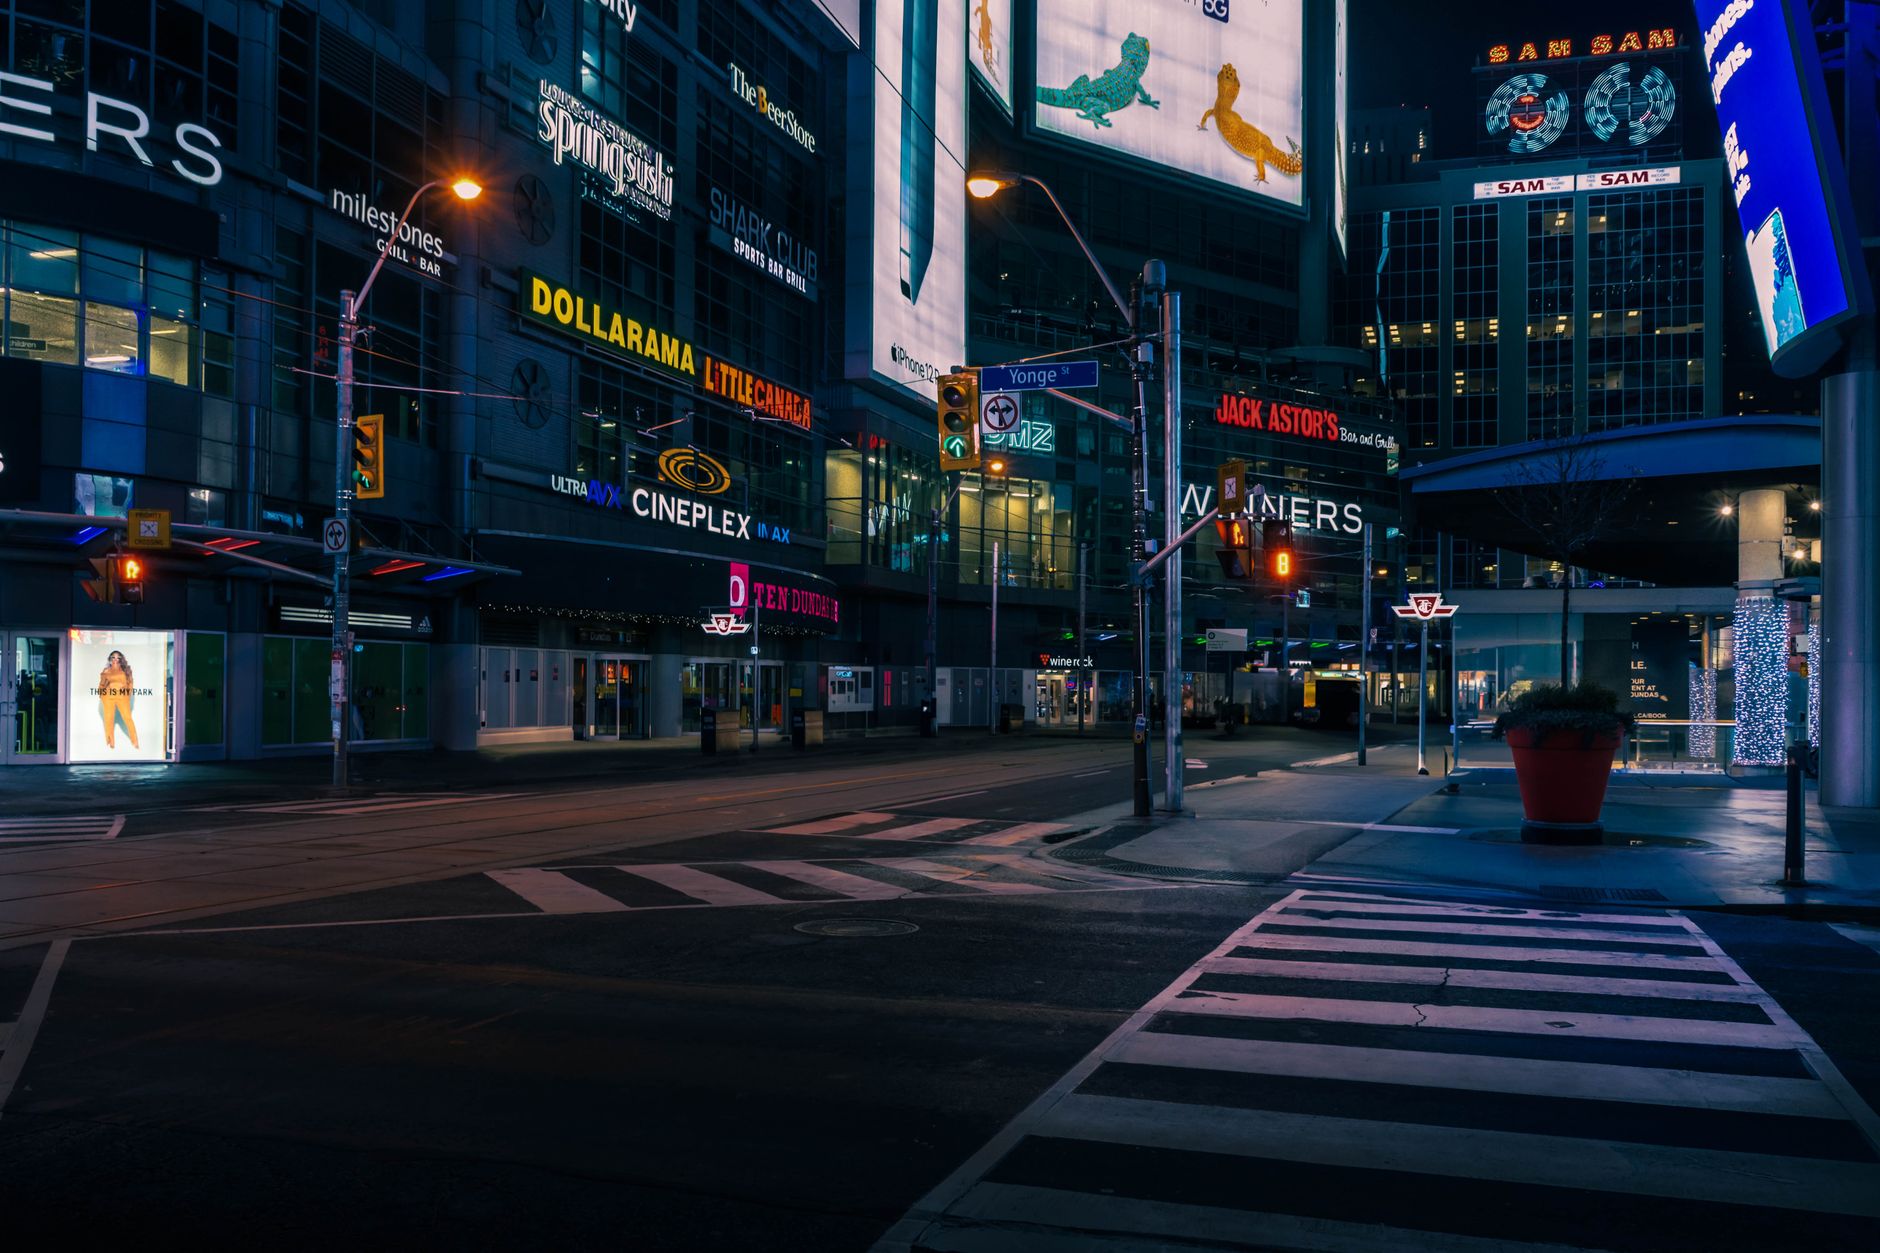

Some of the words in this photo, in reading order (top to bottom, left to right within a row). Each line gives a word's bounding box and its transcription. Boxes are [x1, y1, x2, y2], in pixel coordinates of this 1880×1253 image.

[1489, 39, 1571, 63] SAM
[1591, 28, 1676, 55] SAM
[1498, 180, 1545, 194] SAM
[1601, 171, 1649, 186] SAM
[333, 188, 443, 258] milestones
[710, 187, 772, 256] SHARK
[777, 230, 818, 282] CLUB
[420, 256, 442, 278] BAR
[733, 237, 765, 269] SPORTS
[768, 257, 784, 280] BAR
[786, 268, 807, 294] GRILL
[532, 276, 696, 376] DOLLARAMA
[897, 346, 925, 378] iPhone
[925, 363, 934, 384] 12
[1009, 368, 1057, 387] Yonge
[1061, 366, 1070, 375] St
[1216, 394, 1264, 430] JACK
[1268, 402, 1340, 442] ASTOR'S
[1339, 427, 1358, 444] Bar
[1359, 433, 1374, 446] and
[1375, 435, 1395, 450] Grill
[632, 488, 751, 540] CINEPLEX
[757, 521, 791, 544] IMAX
[1181, 483, 1363, 534] WNERS
[753, 582, 789, 613] TEN
[1050, 655, 1072, 667] wine
[1073, 655, 1093, 667] rck
[1631, 661, 1647, 669] LE.
